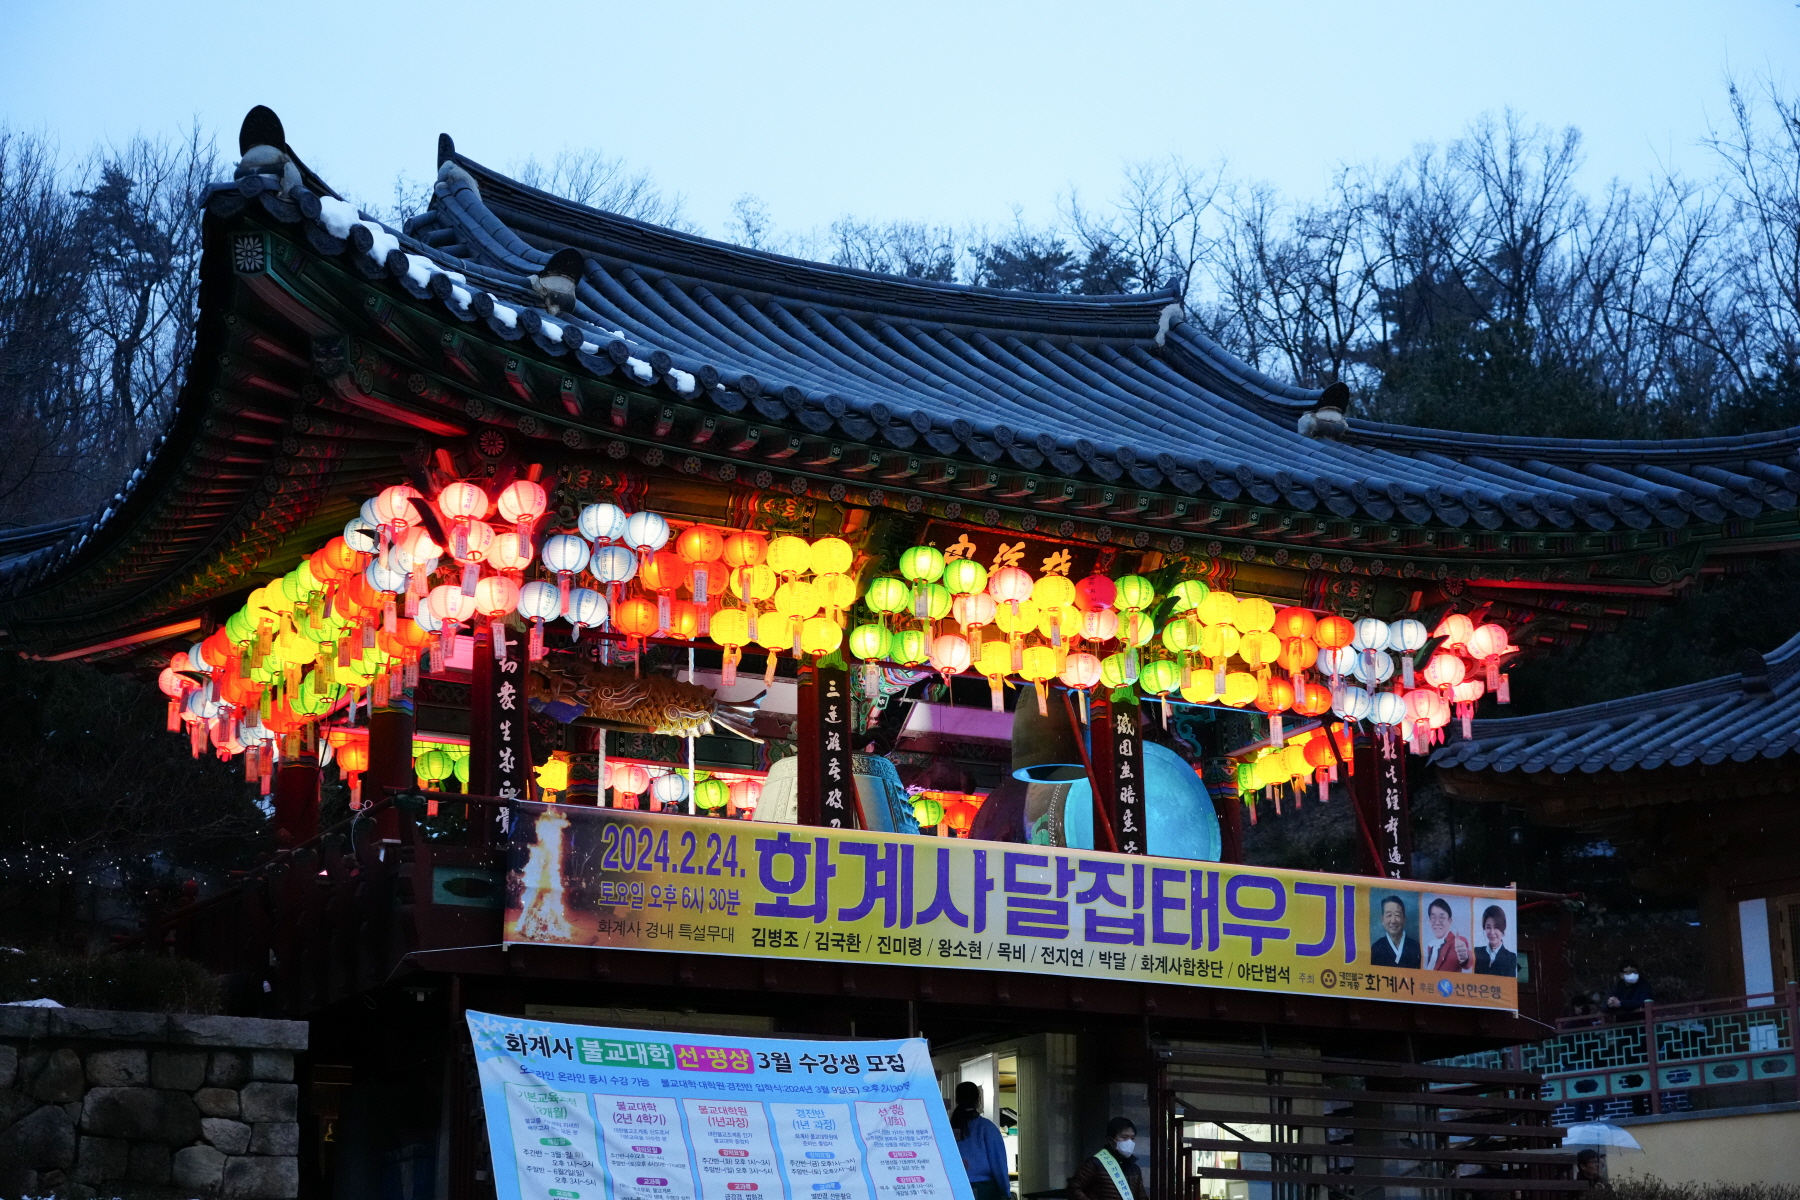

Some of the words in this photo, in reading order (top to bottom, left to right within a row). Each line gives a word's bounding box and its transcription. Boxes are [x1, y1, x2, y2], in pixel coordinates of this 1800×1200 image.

[602, 823, 746, 878] 2024.2.24.
[599, 881, 644, 910] 토요일
[648, 884, 677, 912] 오후
[681, 886, 704, 914] 6시
[709, 887, 741, 916] 30분
[597, 919, 641, 938] 화계사
[645, 922, 674, 940] 경내
[678, 923, 735, 944] 특설무대
[751, 927, 799, 949] 김병조
[814, 931, 861, 953] 김국환
[877, 935, 922, 957] 진미령
[938, 938, 982, 960] 왕소현
[997, 942, 1026, 963] 목비
[1041, 945, 1084, 967] 전지연
[1099, 951, 1127, 971] 박달
[1140, 954, 1224, 979] 화계사합창단
[1237, 962, 1290, 985] 야단법석
[1298, 972, 1315, 985] 주최
[1365, 974, 1415, 995] 화계사
[1419, 982, 1435, 994] 후원
[1454, 983, 1501, 999] 신한은행
[504, 1032, 574, 1060] 화계사
[581, 1039, 670, 1067] 불교대학
[756, 1051, 793, 1074] 3월
[798, 1052, 861, 1074] 수강생
[866, 1053, 906, 1073] 모집
[519, 1064, 555, 1081] 오라인
[558, 1071, 585, 1084] 온라인
[588, 1074, 607, 1085] 동시
[610, 1076, 628, 1086] 수강
[631, 1076, 650, 1087] 가능
[816, 1085, 830, 1094] 3월
[831, 1085, 860, 1095] 9일(토)
[862, 1084, 880, 1094] 오후
[616, 1101, 657, 1112] 불교대학
[698, 1105, 748, 1116] 불교대학원
[612, 1112, 633, 1125] (2년
[636, 1113, 666, 1126] 4학기)
[796, 1109, 825, 1119] 경전반
[708, 1116, 749, 1128] (1년과정)
[792, 1119, 811, 1130] (1년
[813, 1119, 836, 1131] 과정)
[550, 1151, 584, 1160] 3월일(화)
